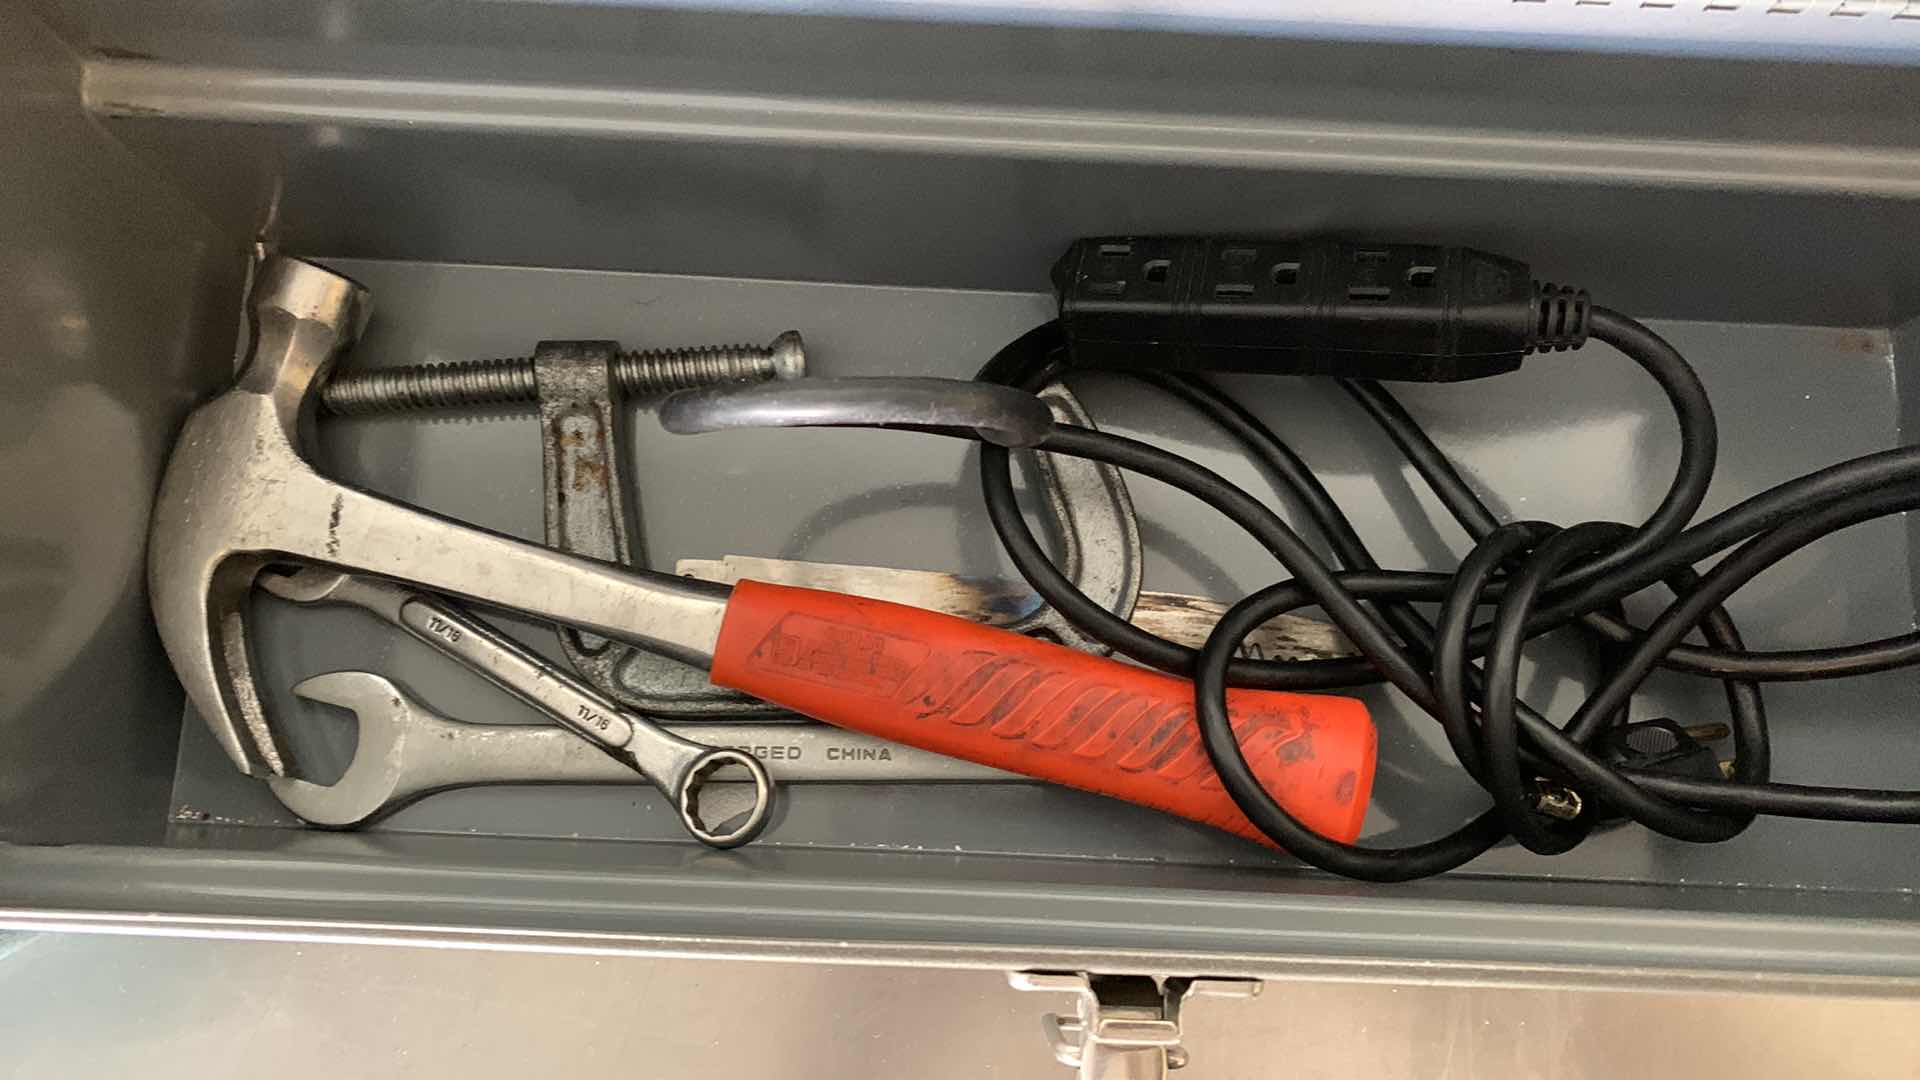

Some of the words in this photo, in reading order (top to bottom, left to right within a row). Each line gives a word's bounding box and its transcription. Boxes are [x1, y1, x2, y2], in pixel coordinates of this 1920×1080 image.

[426, 615, 462, 643] 11/16
[576, 704, 610, 731] 11/16
[826, 747, 893, 761] CHINA
